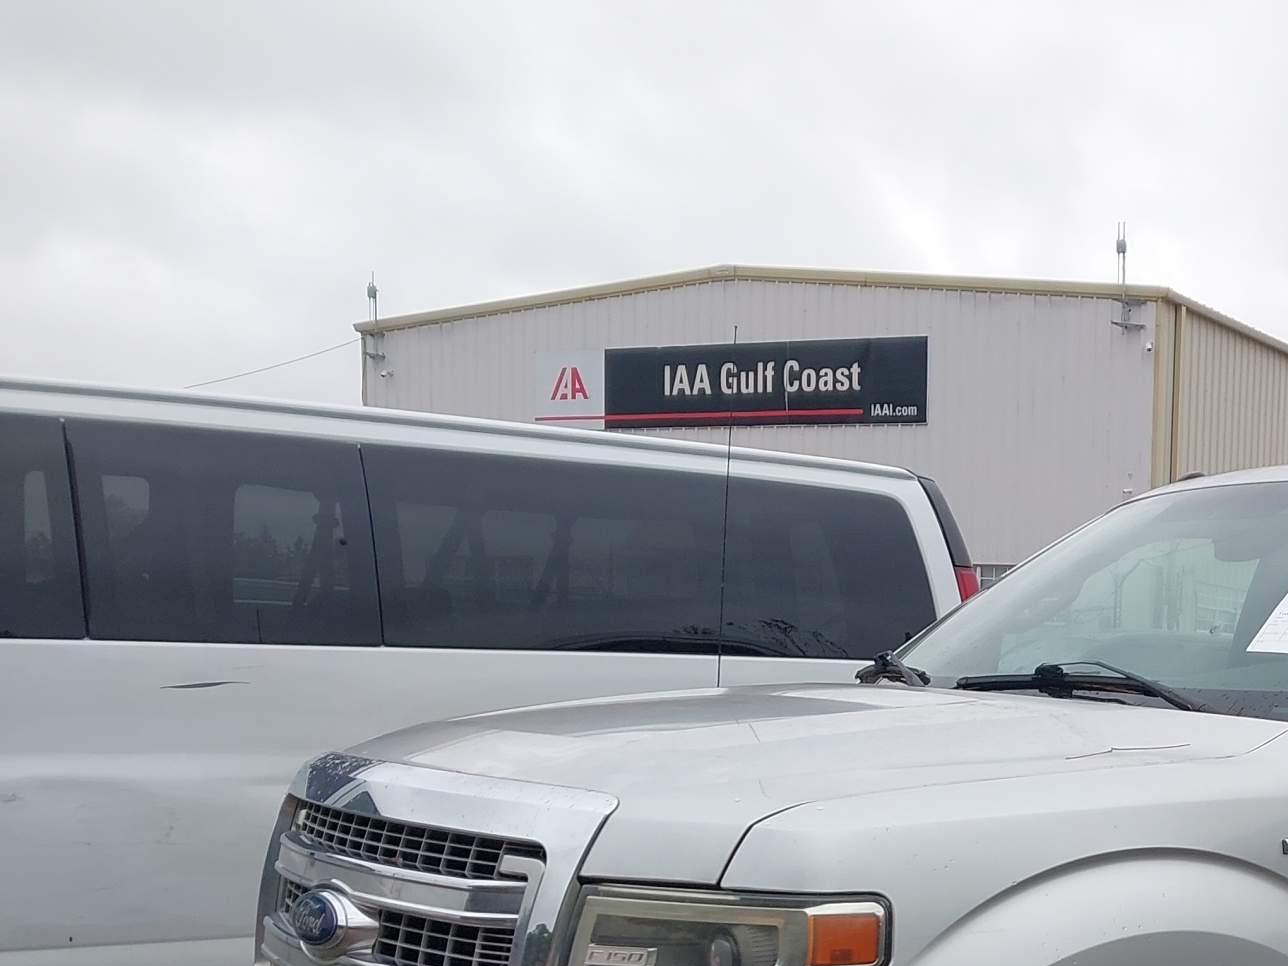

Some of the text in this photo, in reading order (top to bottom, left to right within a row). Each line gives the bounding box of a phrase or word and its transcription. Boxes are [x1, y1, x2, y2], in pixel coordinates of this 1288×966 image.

[663, 359, 861, 396] IAA Gulf Coast
[871, 403, 918, 417] IAAI.com
[295, 898, 326, 935] Ford
